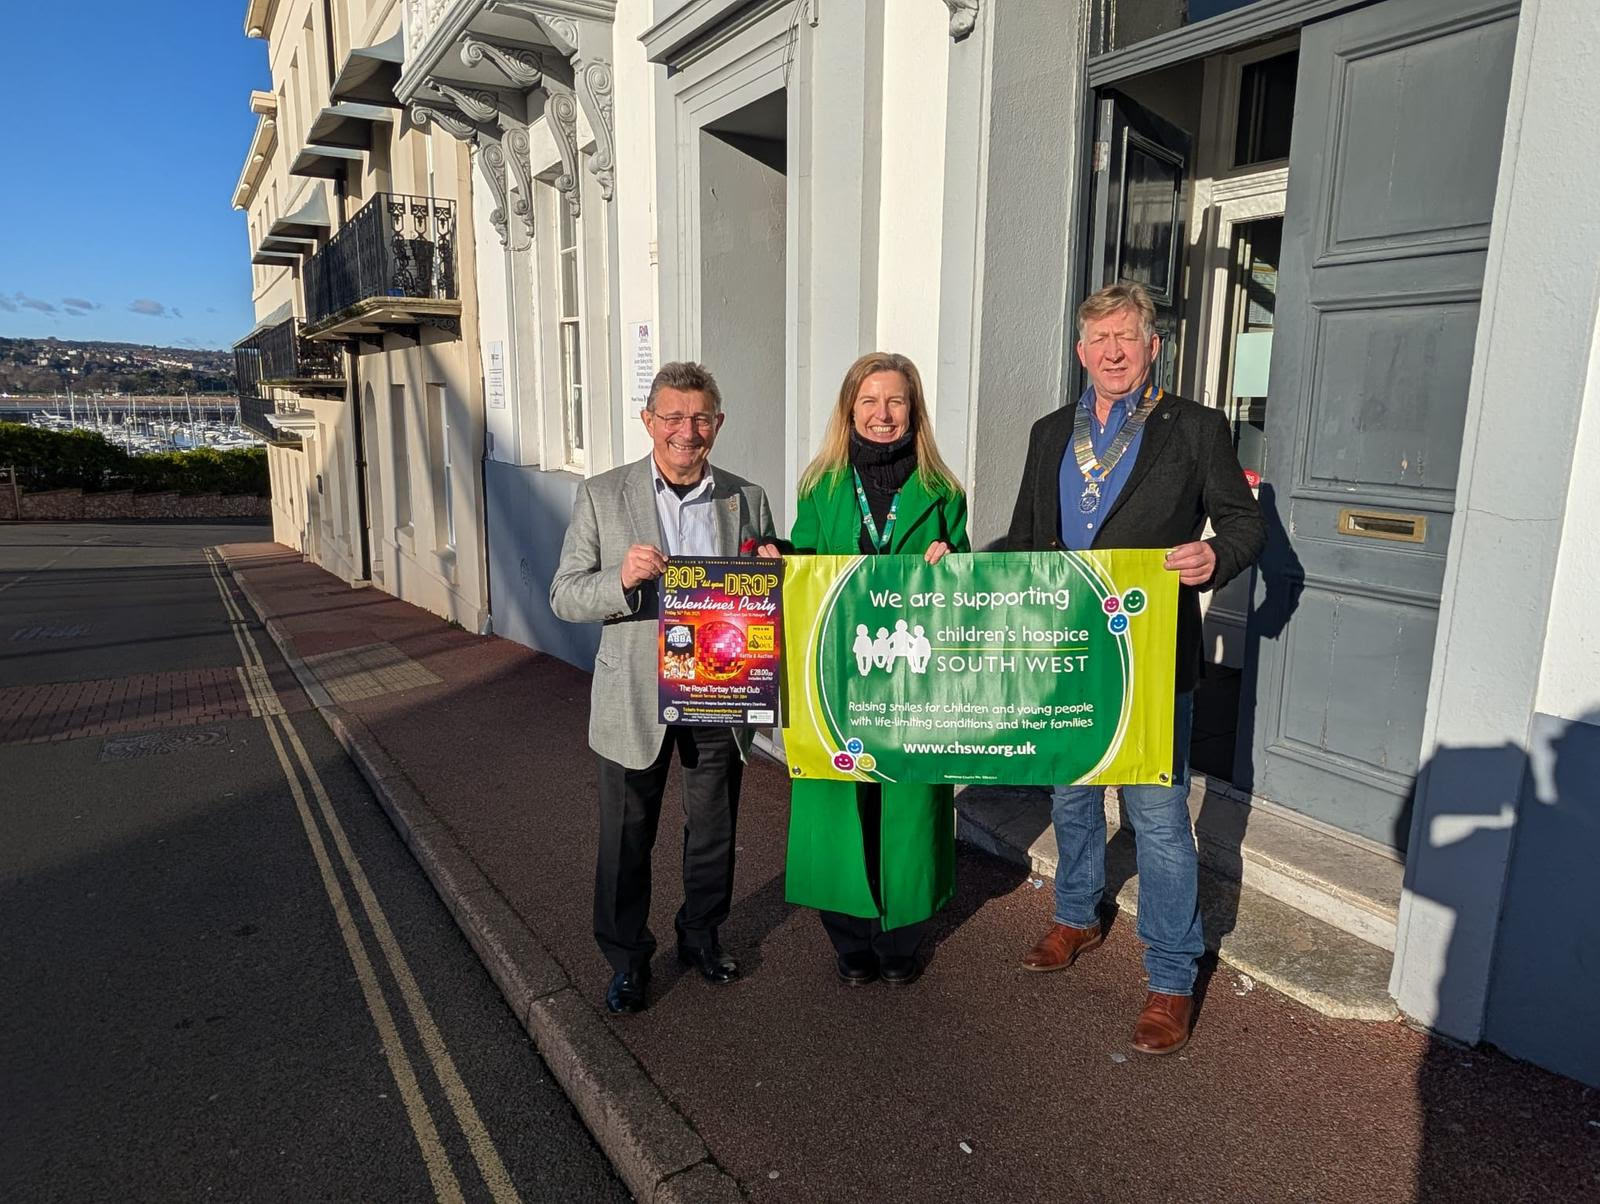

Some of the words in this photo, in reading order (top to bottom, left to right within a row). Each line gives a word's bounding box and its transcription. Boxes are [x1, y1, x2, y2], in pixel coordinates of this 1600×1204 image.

[664, 566, 706, 588] BOP
[724, 573, 778, 596] DROP
[663, 595, 735, 610] Valentines
[738, 596, 777, 616] Party
[869, 590, 903, 608] We
[910, 592, 946, 608] are
[953, 586, 1070, 610] supporting
[667, 634, 692, 643] ABBA
[936, 626, 1016, 642] children's
[1022, 625, 1089, 647] hospice
[937, 656, 1015, 673] SOUTH
[1025, 655, 1089, 673] WEST
[709, 685, 729, 694] Torbay
[848, 702, 886, 713] Raising
[889, 703, 922, 712] smiles
[924, 702, 940, 712] for
[944, 702, 988, 713] children
[992, 704, 1015, 714] and
[1017, 705, 1052, 716] young
[1055, 702, 1094, 716] people
[850, 716, 872, 726] with
[875, 716, 932, 729] life-limiting
[936, 718, 993, 728] conditions
[996, 719, 1018, 729] and
[1021, 719, 1048, 730] their
[1050, 718, 1094, 729] families
[903, 742, 1037, 757] www.chsw.org.uk
